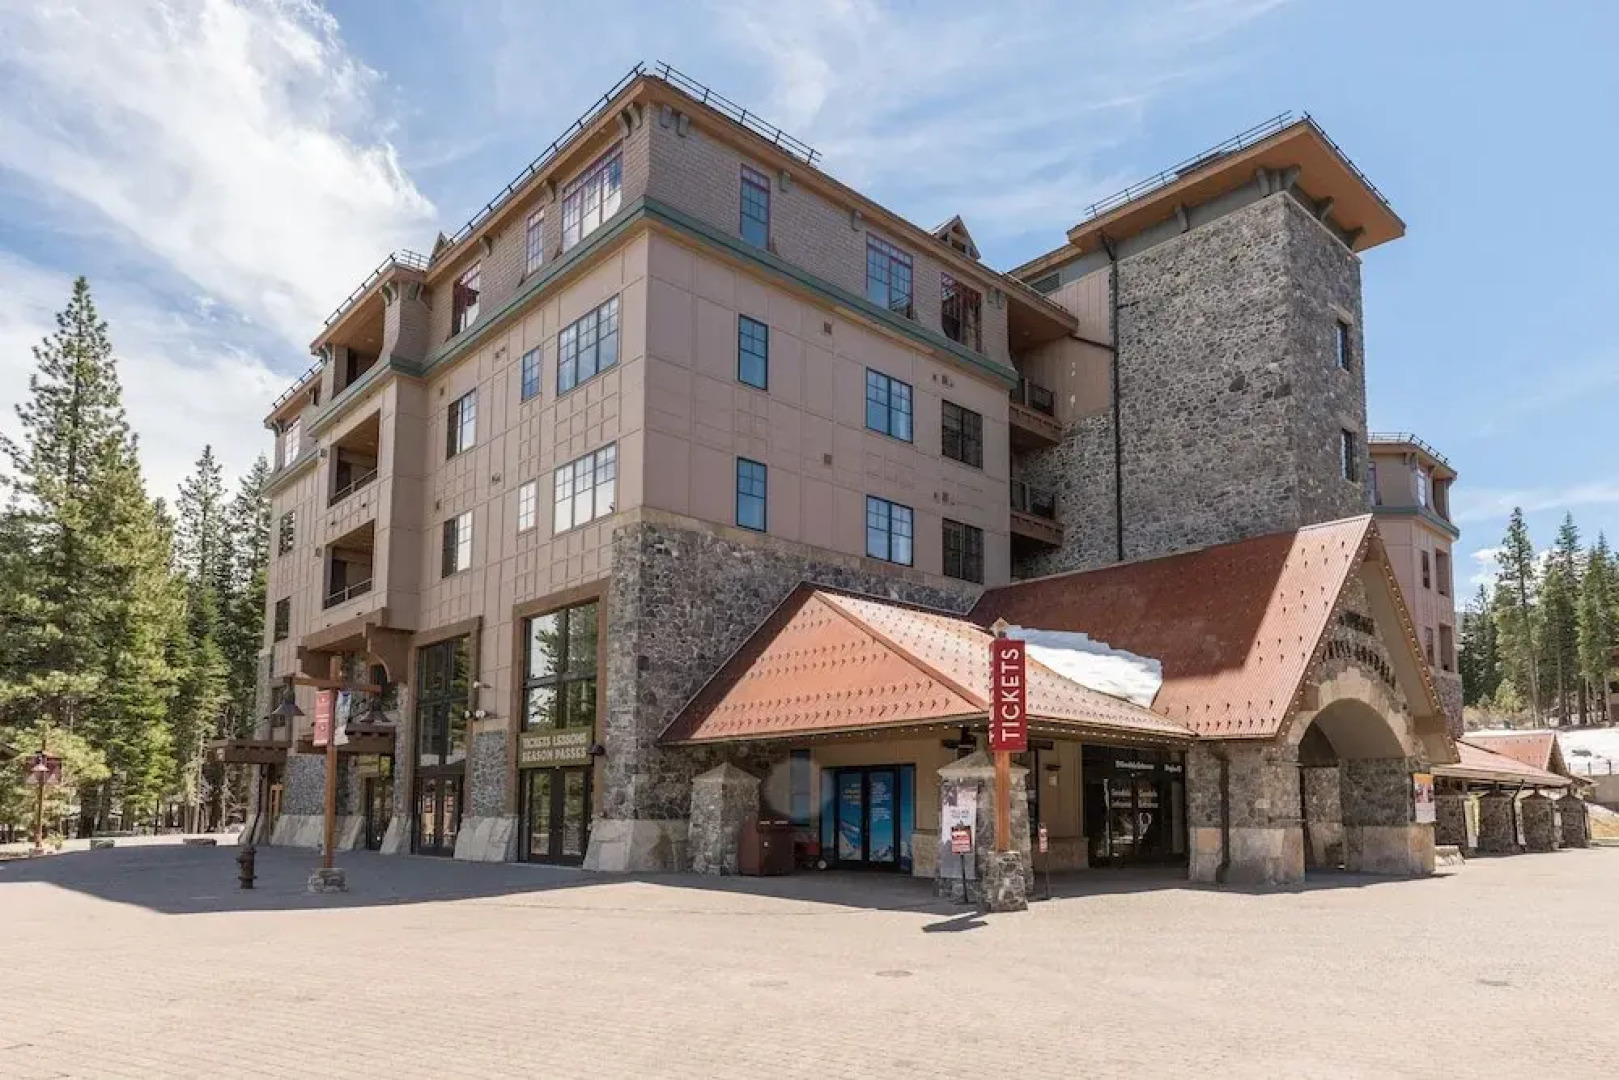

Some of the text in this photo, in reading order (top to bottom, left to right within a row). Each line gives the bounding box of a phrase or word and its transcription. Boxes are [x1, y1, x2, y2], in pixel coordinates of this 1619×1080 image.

[1001, 648, 1020, 743] TICKETS
[552, 732, 587, 746] LESSONS
[522, 747, 587, 762] SEASON PASSES
